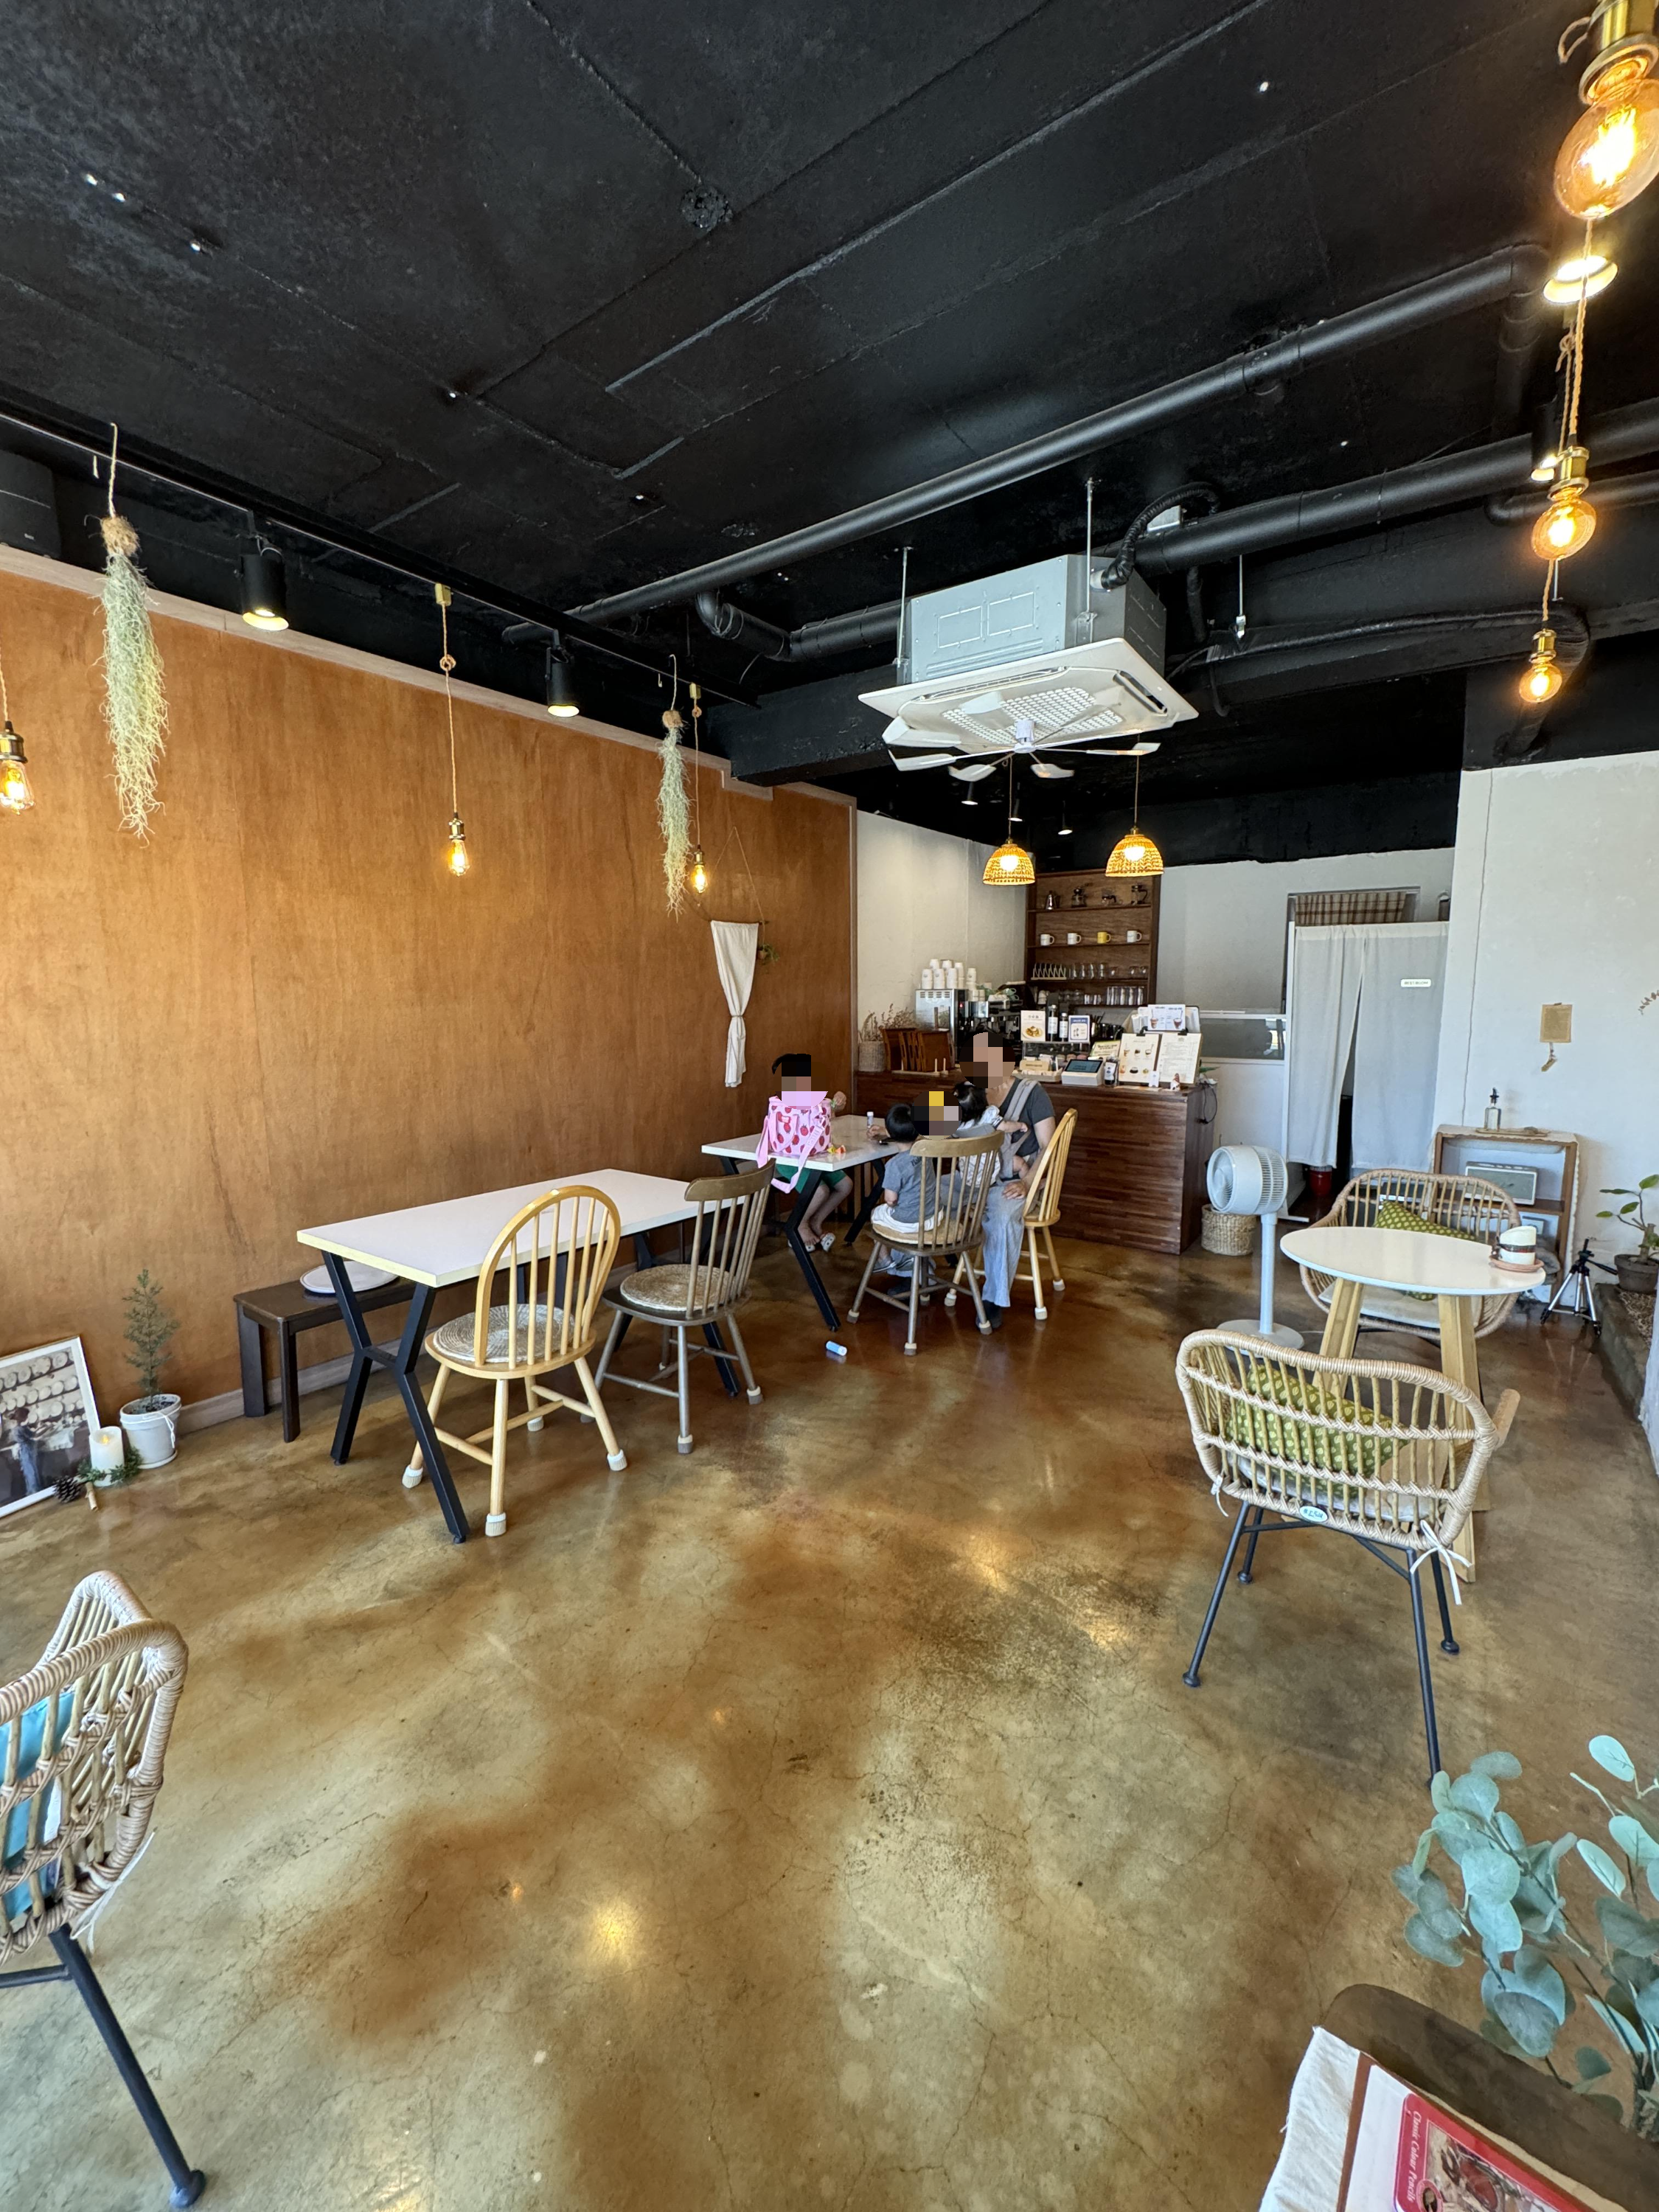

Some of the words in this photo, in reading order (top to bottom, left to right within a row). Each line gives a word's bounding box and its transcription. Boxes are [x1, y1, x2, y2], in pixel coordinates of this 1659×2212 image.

[1412, 2111, 1422, 2140] Classic
[1410, 2140, 1419, 2171] Colour
[1407, 2170, 1417, 2202] Pencils
